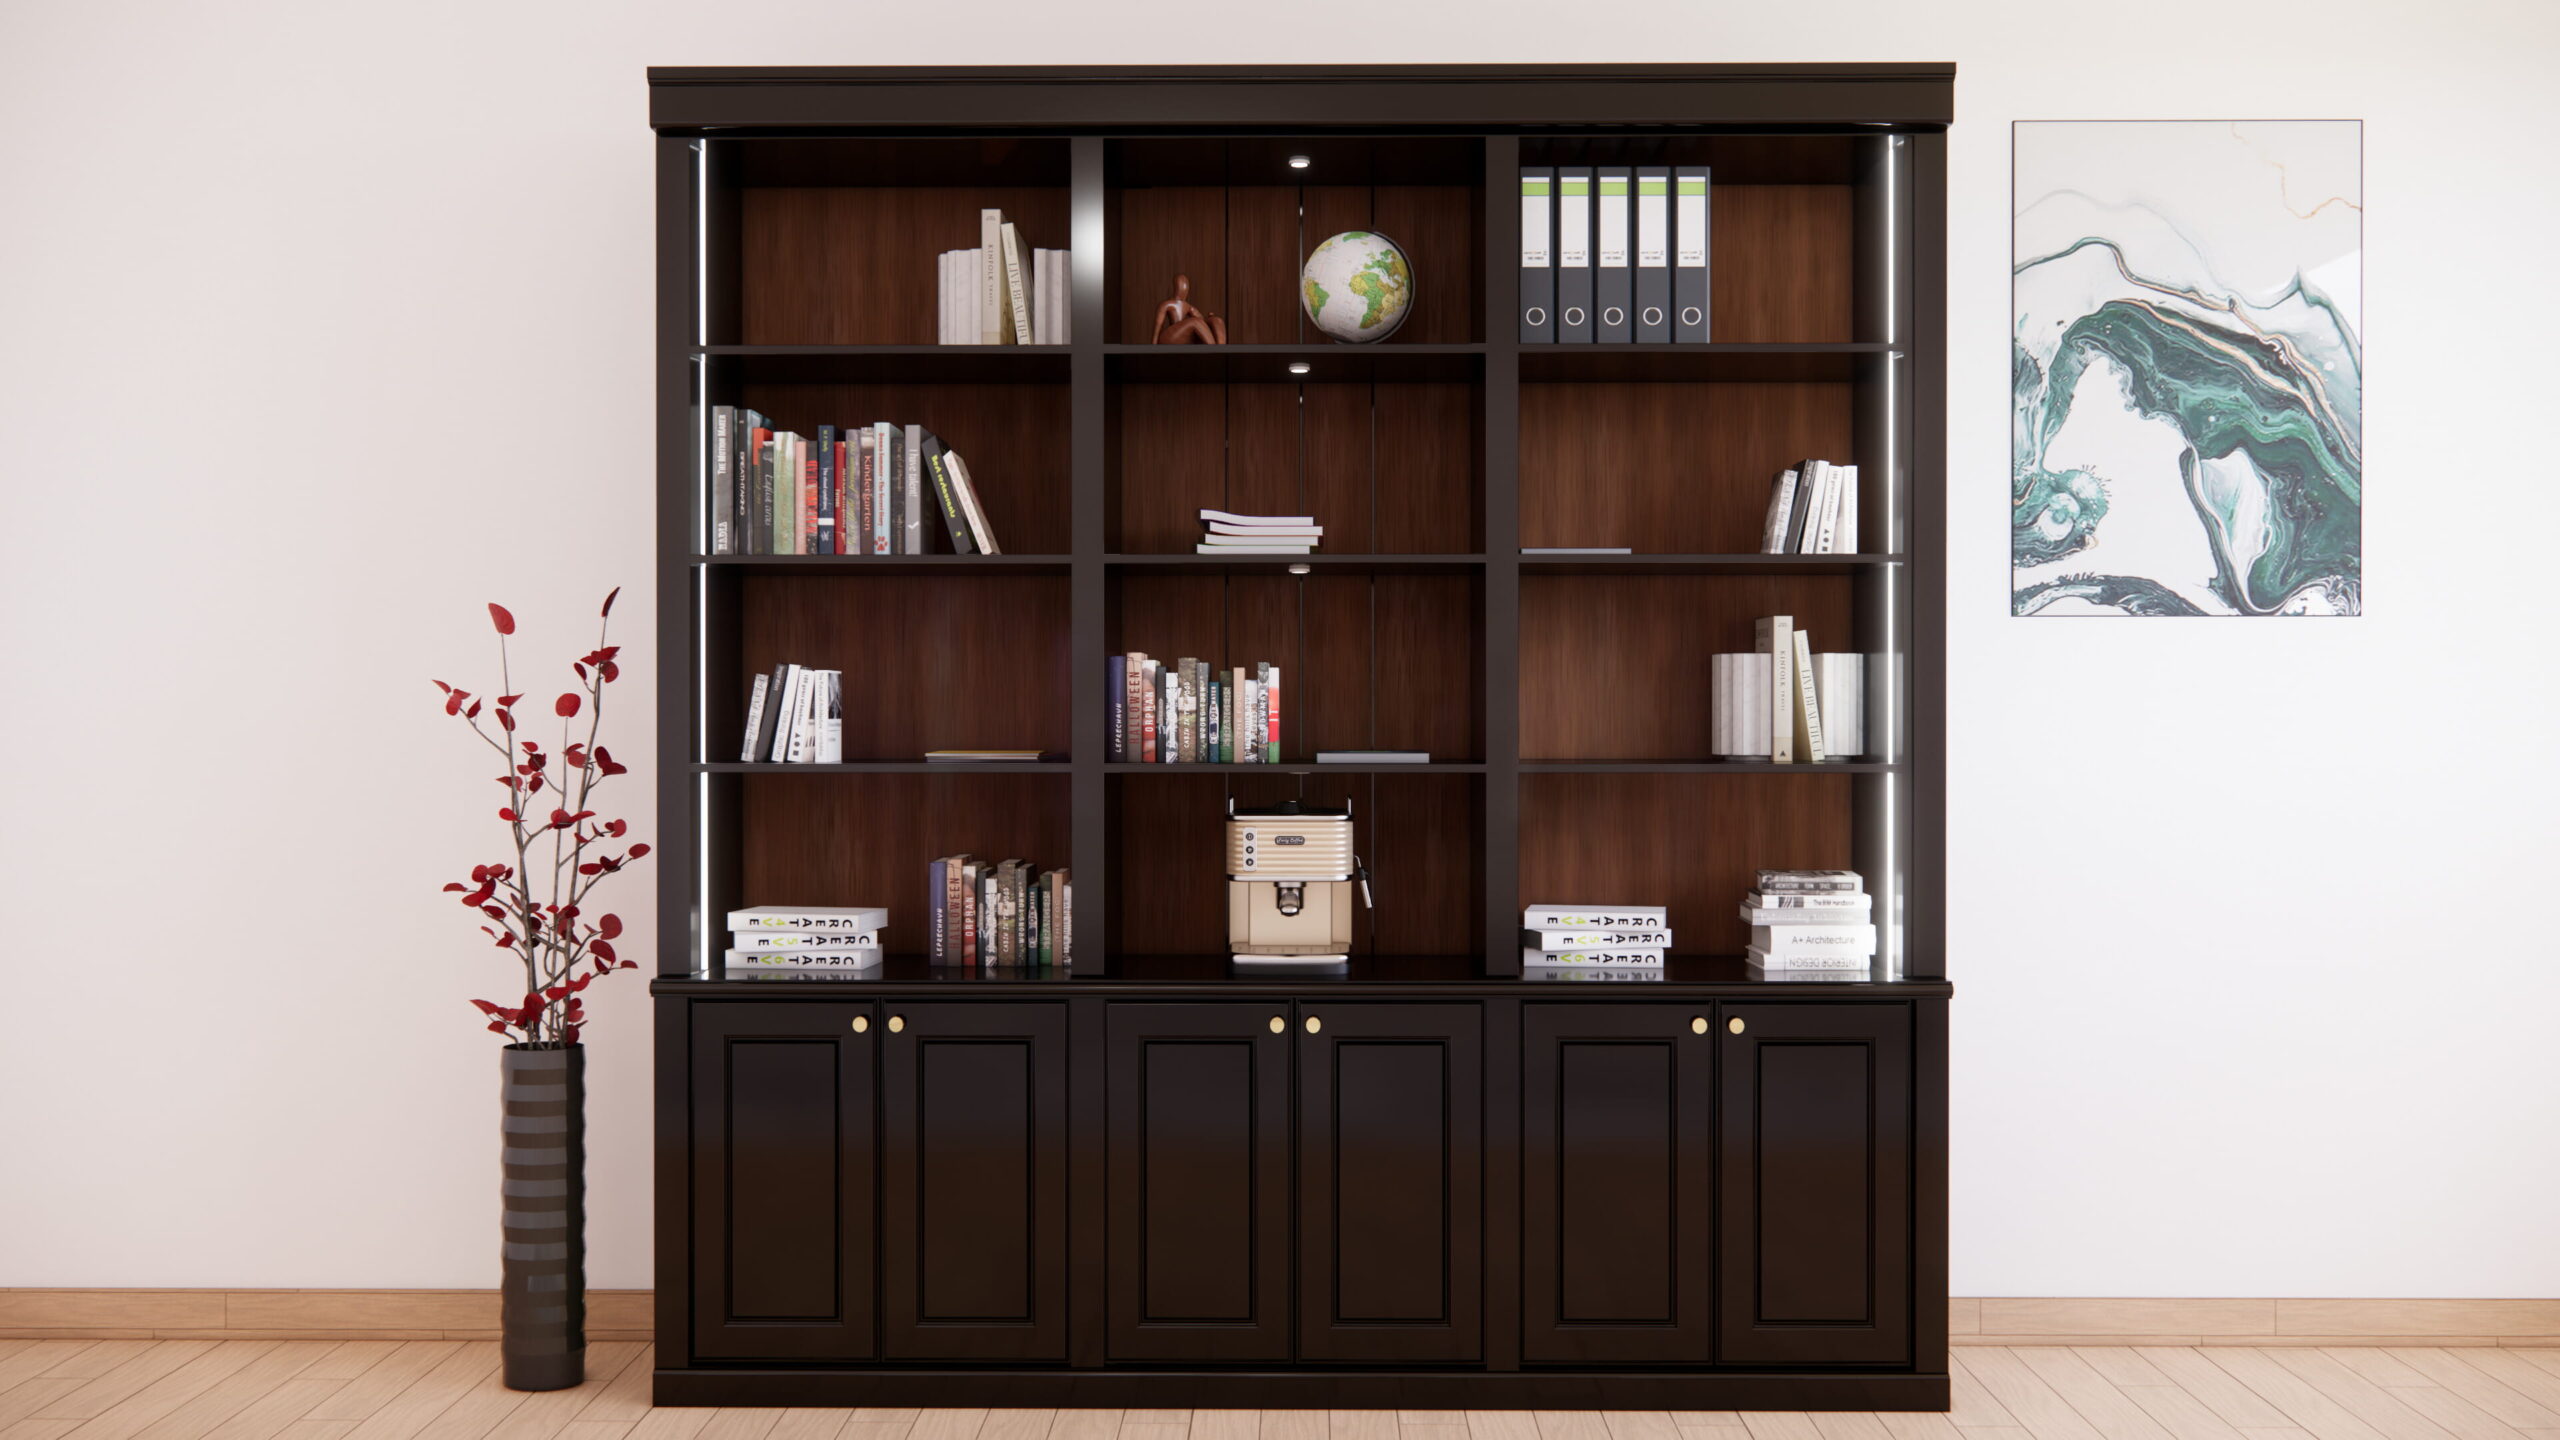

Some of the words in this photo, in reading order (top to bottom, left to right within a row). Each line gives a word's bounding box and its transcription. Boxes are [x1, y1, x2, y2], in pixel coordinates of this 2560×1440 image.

[1008, 262, 1020, 288] LIVE
[717, 414, 727, 437] MAKER
[717, 437, 727, 462] MOTION
[717, 462, 727, 474] THE
[908, 453, 918, 472] have
[862, 455, 872, 531] Kindergarten
[908, 473, 919, 497] talent!
[931, 454, 942, 474] Best
[937, 474, 956, 518] restaurants
[799, 684, 807, 698] years
[1800, 669, 1814, 694] LIVE
[1128, 671, 1140, 744] HALLOWEEN
[1144, 691, 1154, 732] ORPHAN
[1259, 689, 1267, 736] SNOWMAN
[1269, 709, 1279, 722] IT
[1805, 696, 1822, 756] BEAUTIFUL
[949, 877, 961, 950] HALLOWEEN
[965, 896, 974, 937] ORPHAN
[1791, 935, 1803, 945] A+
[1805, 935, 1856, 945] Architecture
[1789, 958, 1820, 967] DESIGN
[1822, 959, 1856, 968] INTERIOR
